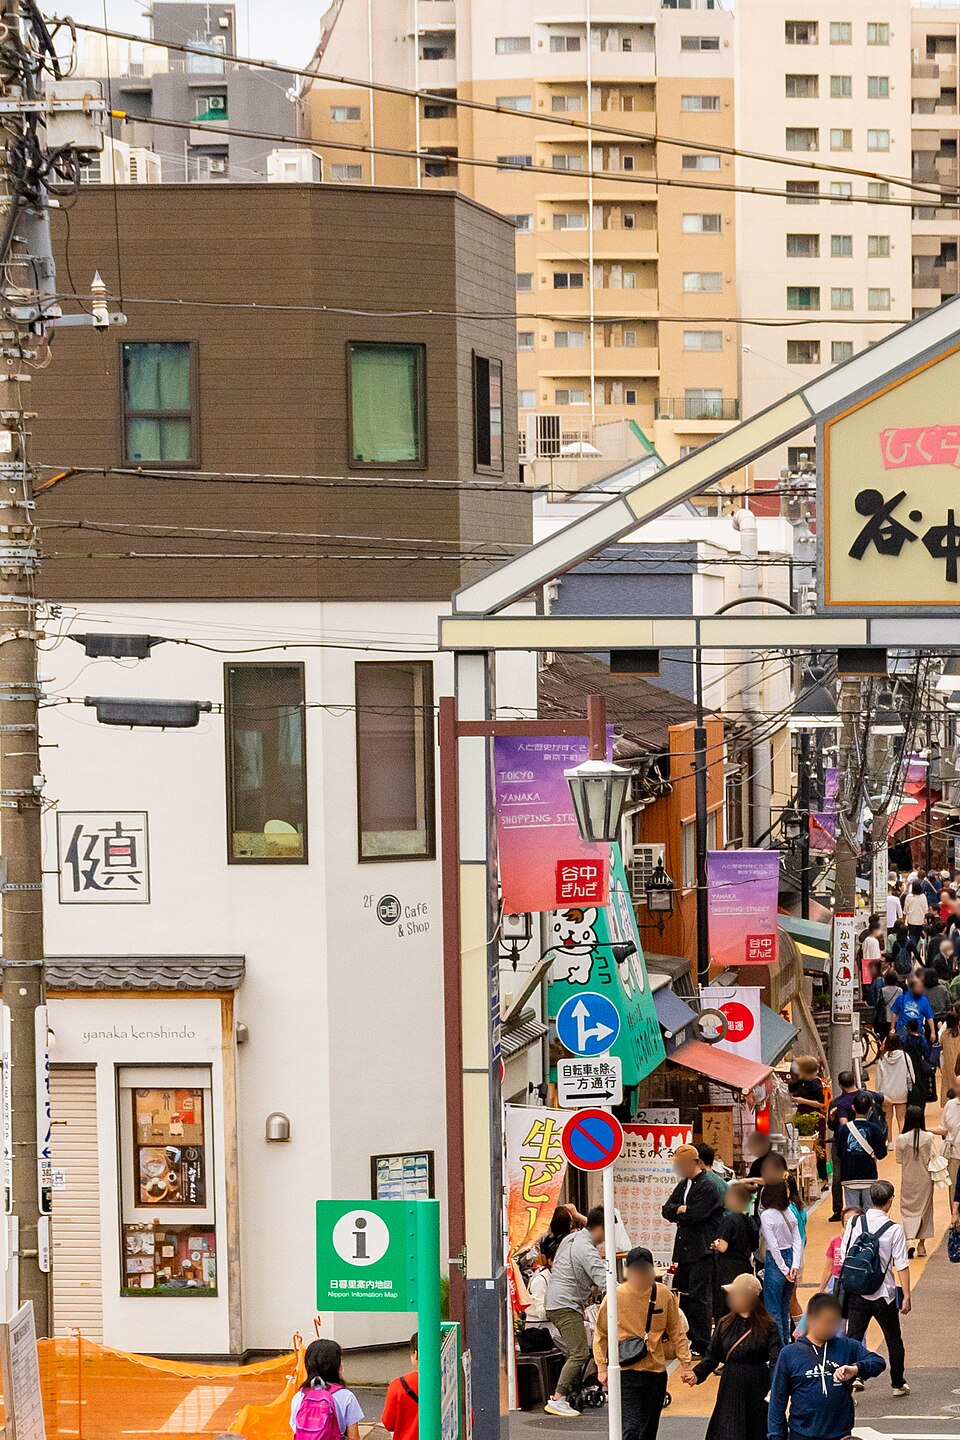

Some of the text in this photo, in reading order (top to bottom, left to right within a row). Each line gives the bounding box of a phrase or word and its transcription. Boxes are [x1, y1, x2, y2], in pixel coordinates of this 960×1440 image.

[499, 770, 534, 781] TOKYO
[500, 792, 541, 803] YANAKA
[501, 812, 577, 826] SHOPPING STR
[561, 865, 598, 882] 谷中
[560, 881, 598, 899] ぎんざ
[362, 894, 375, 908] 2F
[404, 902, 428, 919] Café
[397, 921, 430, 938] & Shop
[749, 938, 772, 948] 谷中
[749, 949, 772, 959] ぎんざ
[83, 1025, 196, 1043] yanaka kenshindo
[562, 1062, 616, 1077] 自転車を除く
[563, 1076, 617, 1091] 一方通行
[329, 1279, 393, 1290] 日暮里案内地図
[384, 1290, 398, 1299] Map
